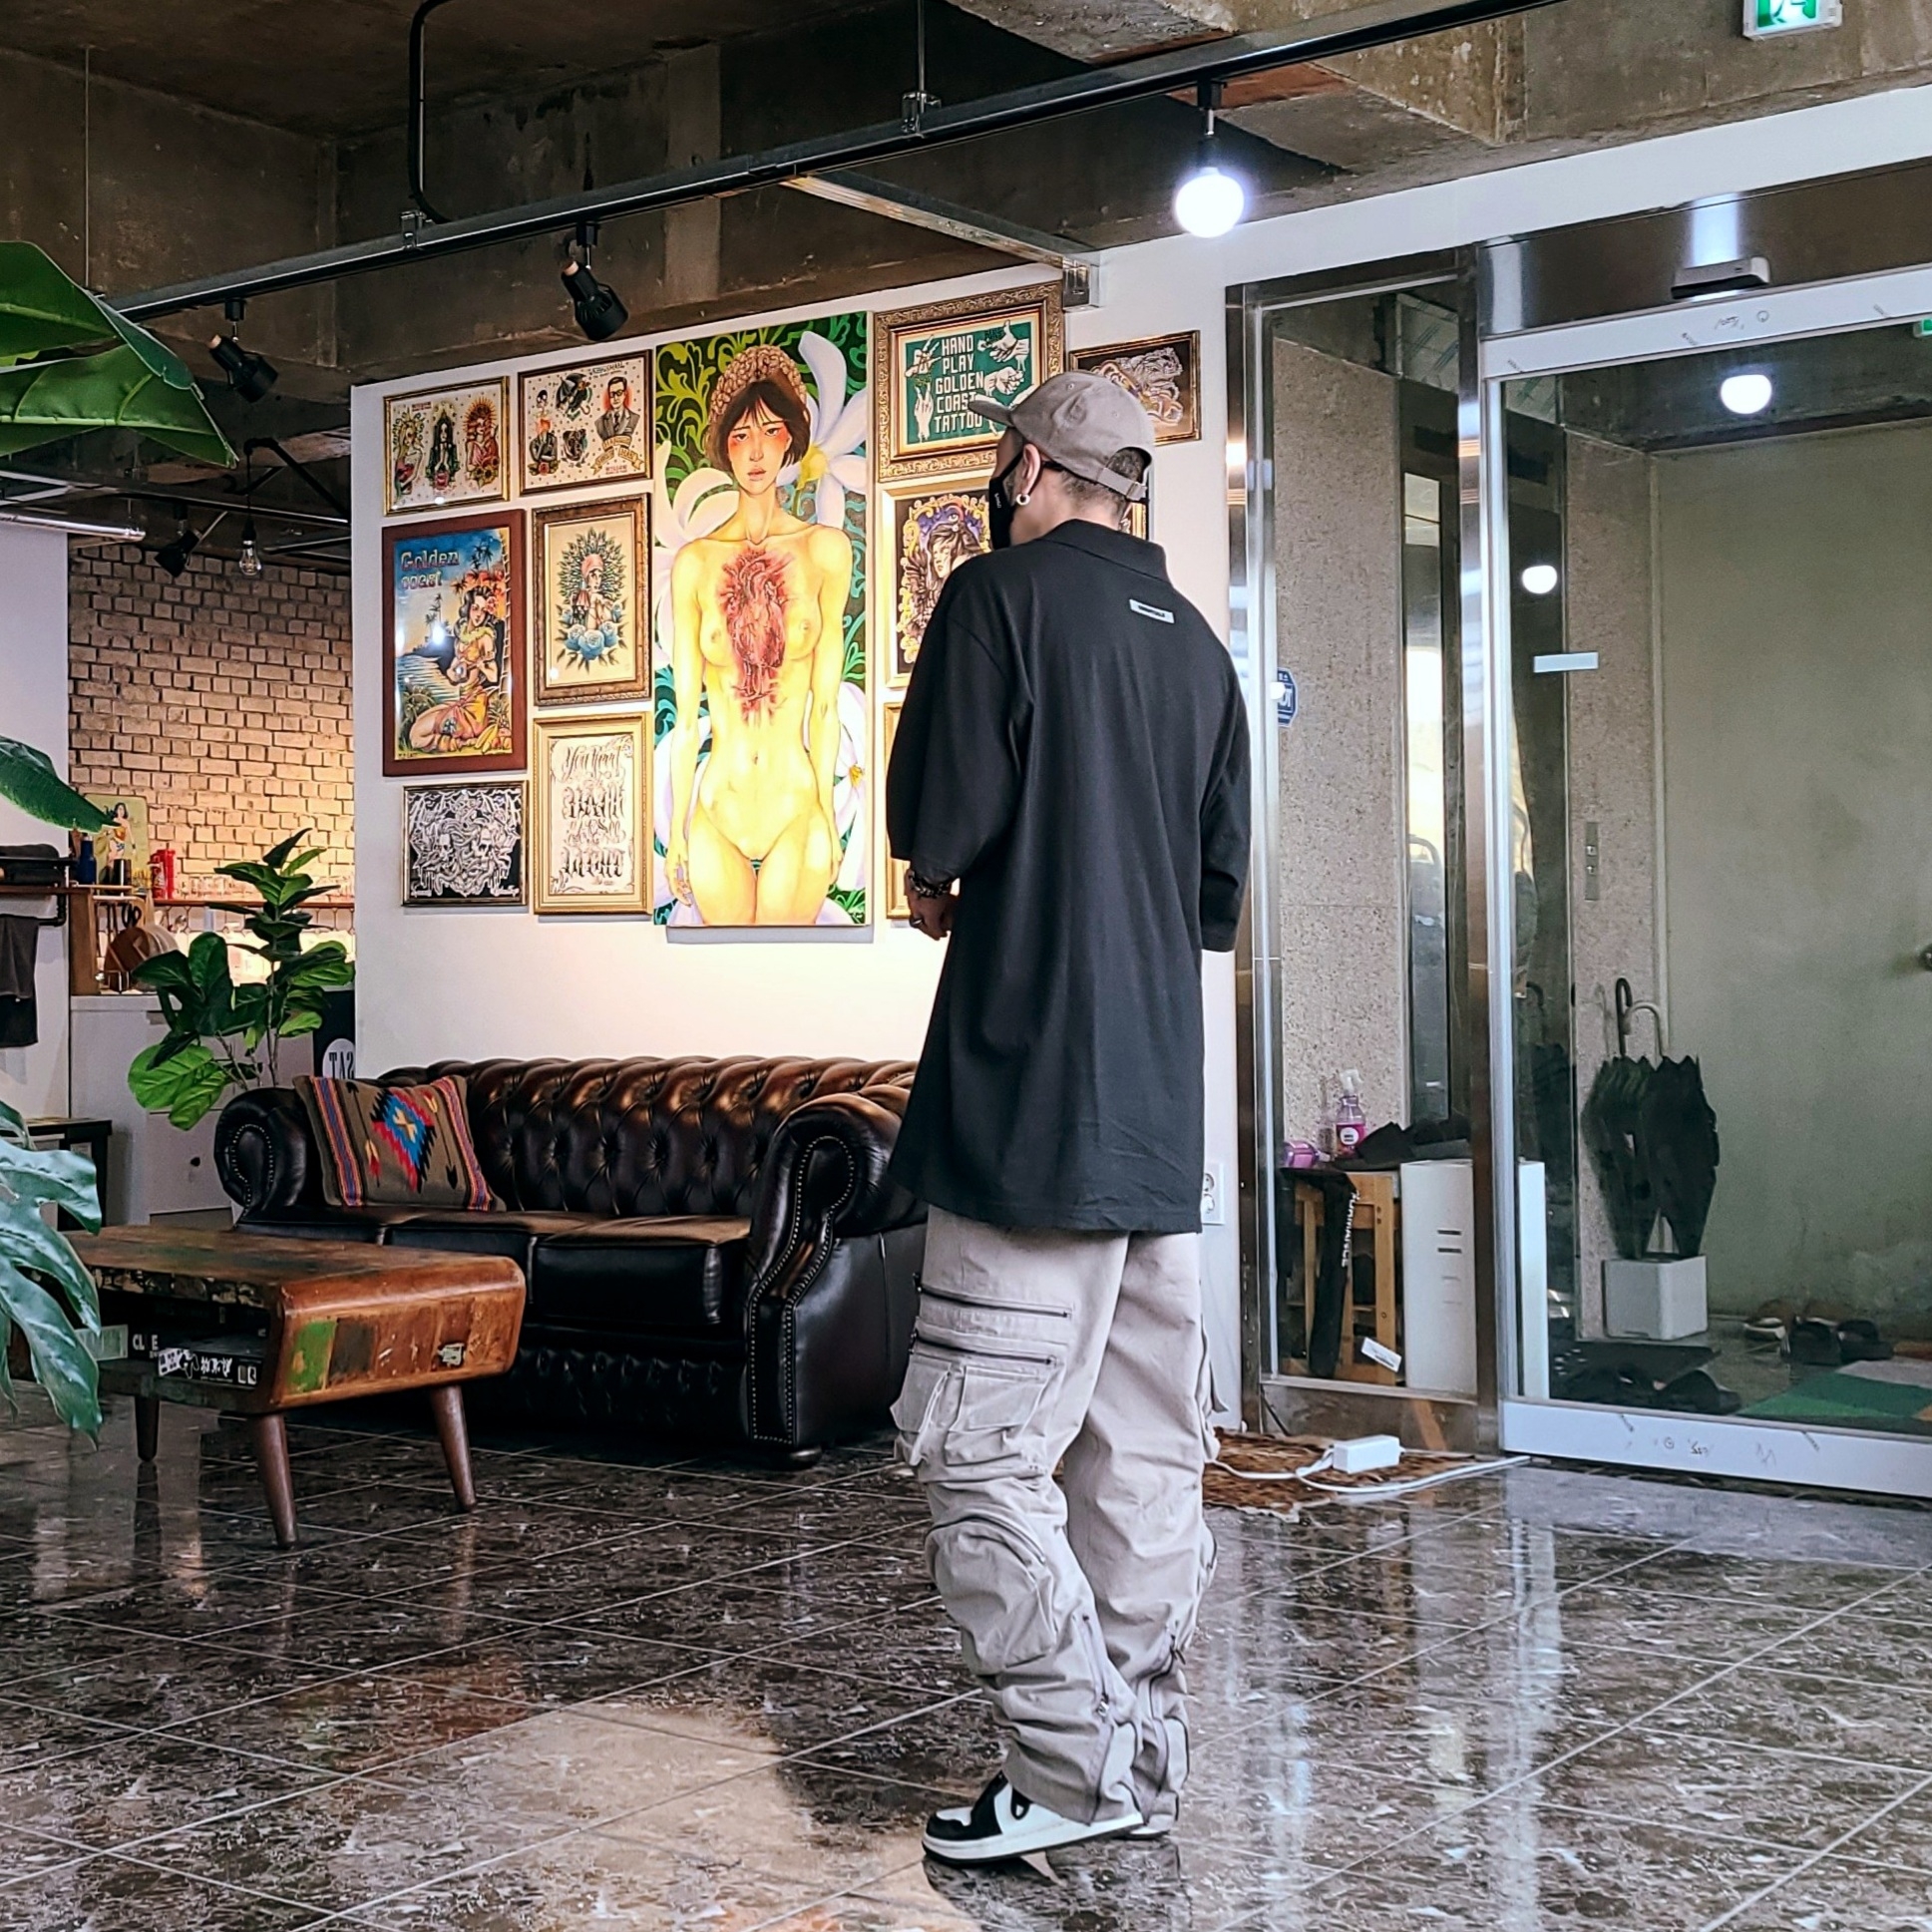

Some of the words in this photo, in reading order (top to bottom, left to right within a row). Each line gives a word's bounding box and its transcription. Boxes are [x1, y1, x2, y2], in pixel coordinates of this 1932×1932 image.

[942, 334, 973, 356] HAND
[943, 353, 974, 375] PLAY
[935, 371, 984, 394] GOLDEN
[937, 391, 977, 414] COAST
[934, 411, 983, 433] TATTOO
[401, 549, 460, 571] Golden
